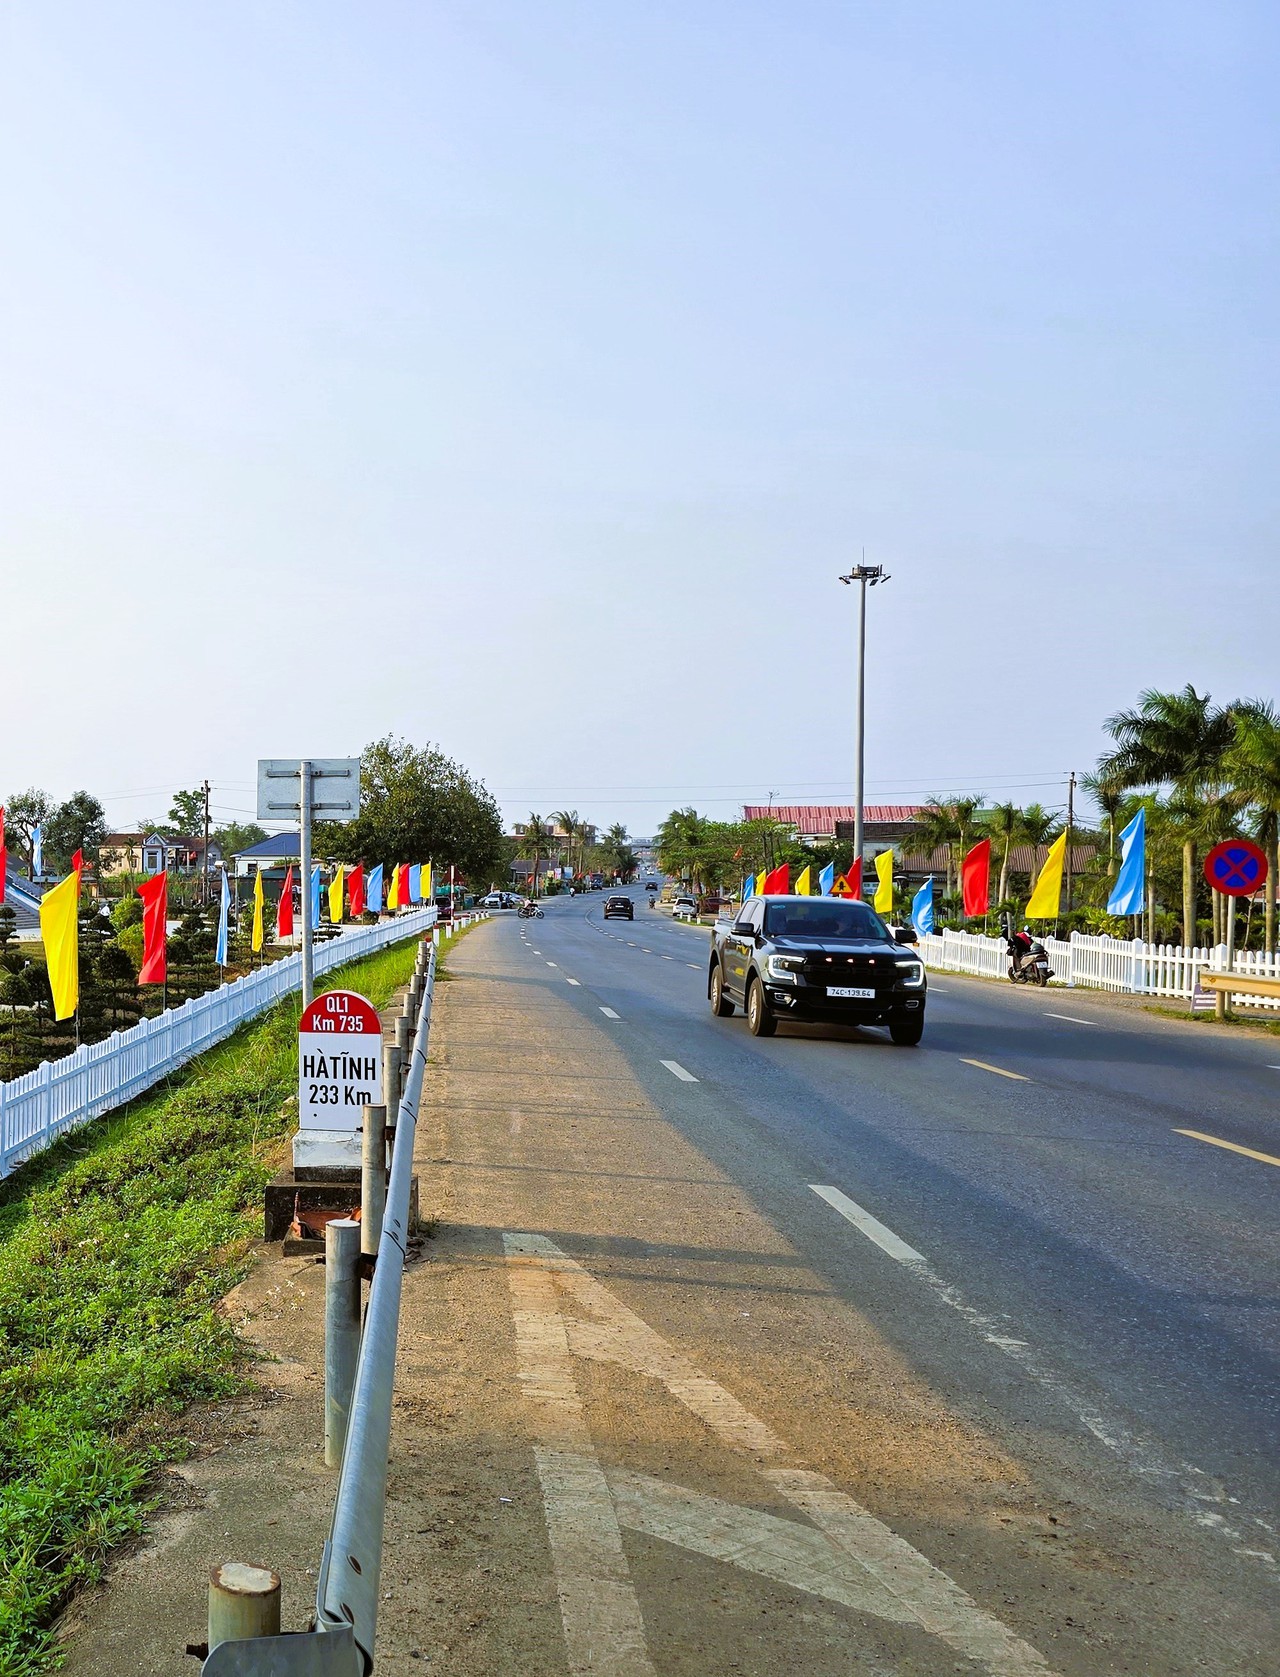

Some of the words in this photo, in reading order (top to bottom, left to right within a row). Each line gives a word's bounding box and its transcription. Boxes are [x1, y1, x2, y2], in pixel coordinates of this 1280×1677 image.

[326, 996, 349, 1013] QL1
[312, 1014, 335, 1032] Km
[339, 1015, 364, 1032] 735
[308, 1084, 339, 1105] 233
[344, 1085, 372, 1106] Km
